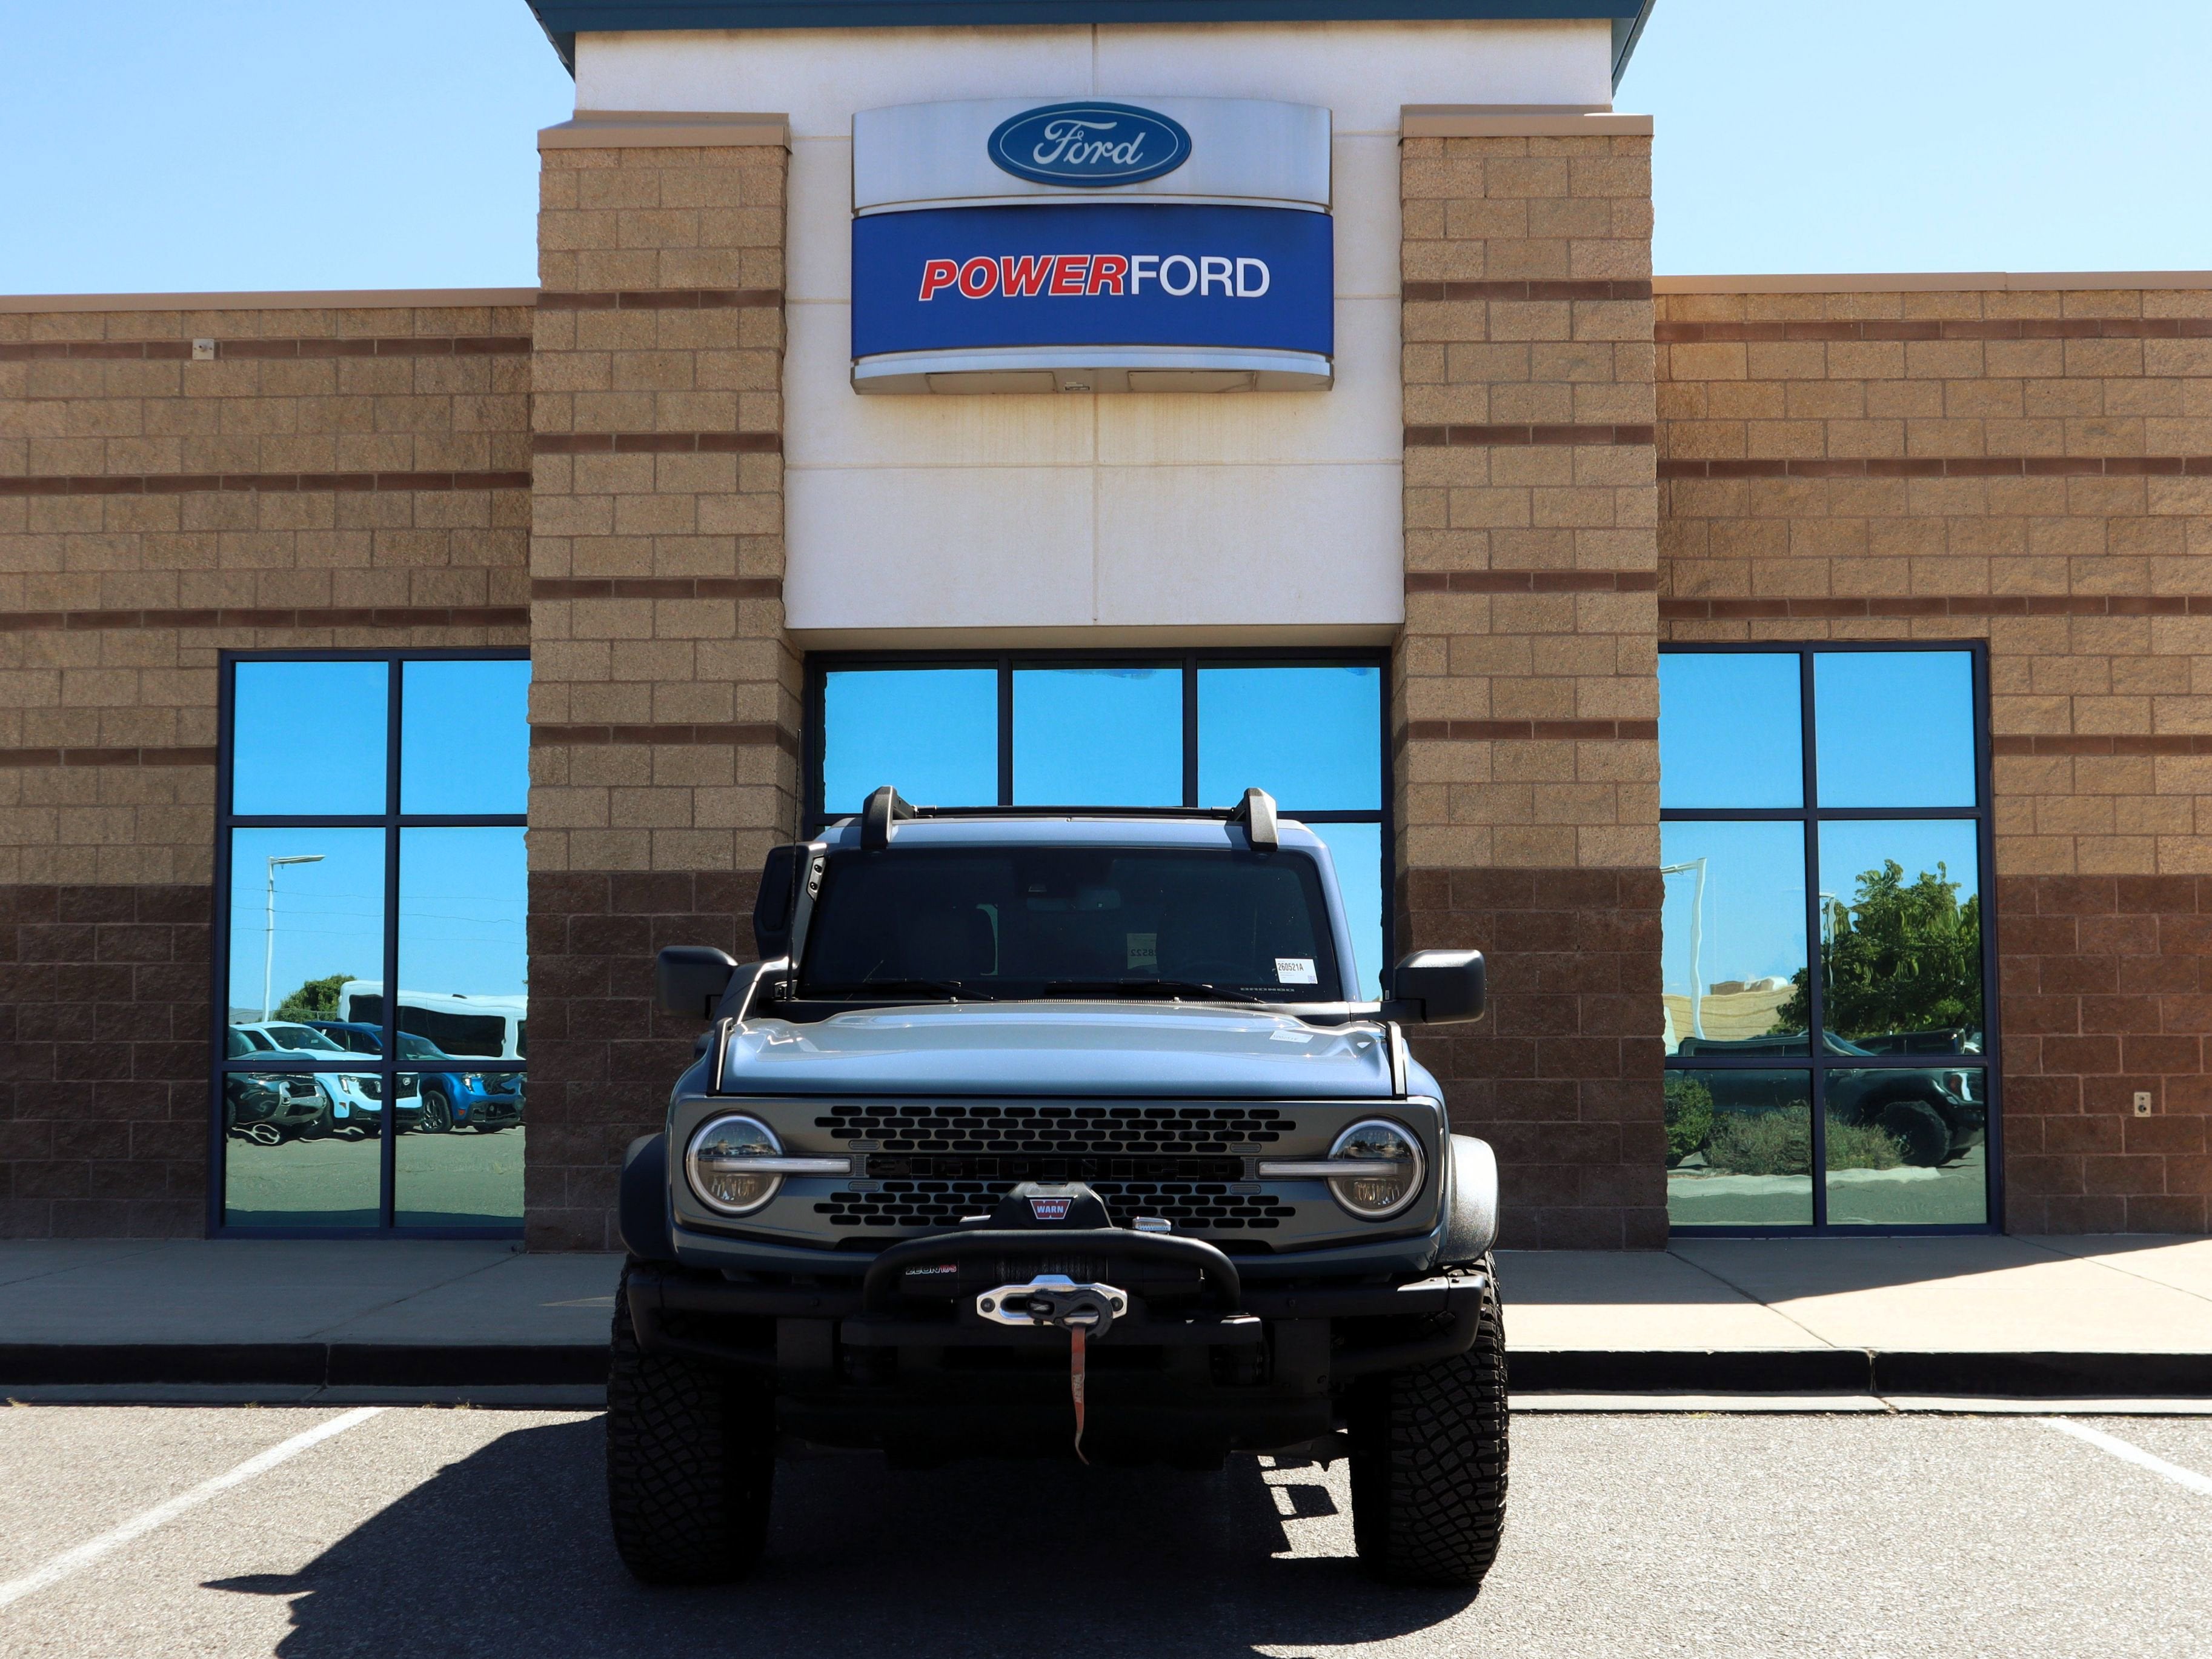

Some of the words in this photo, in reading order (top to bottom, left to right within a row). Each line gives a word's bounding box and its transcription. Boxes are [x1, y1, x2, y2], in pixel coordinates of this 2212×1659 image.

[1033, 119, 1146, 165] Ford
[918, 254, 1270, 302] POWERFORD
[1277, 962, 1304, 971] 260521A
